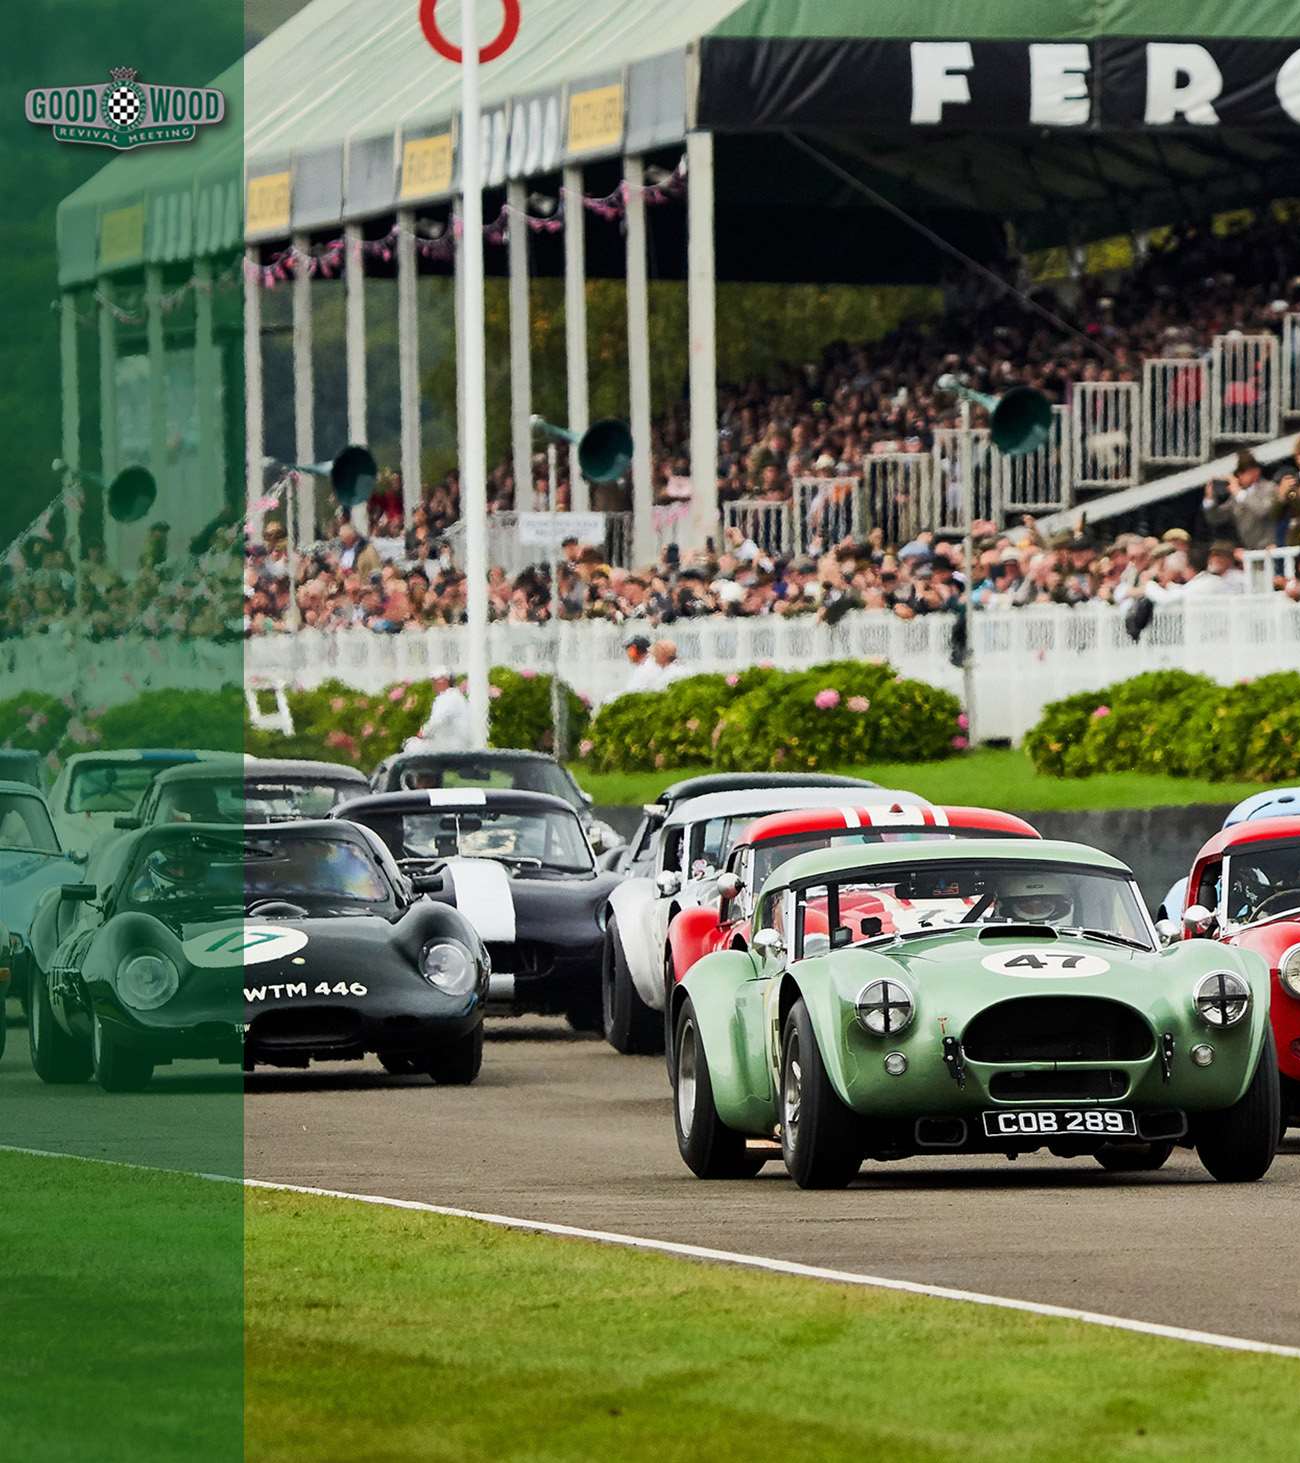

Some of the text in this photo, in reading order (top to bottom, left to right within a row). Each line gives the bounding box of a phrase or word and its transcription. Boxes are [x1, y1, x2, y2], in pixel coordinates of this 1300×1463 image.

[205, 931, 285, 952] 17
[1004, 954, 1085, 969] 47
[243, 981, 368, 1002] WTM 446
[234, 1023, 251, 1033] TOW
[998, 1111, 1125, 1132] COB 289
